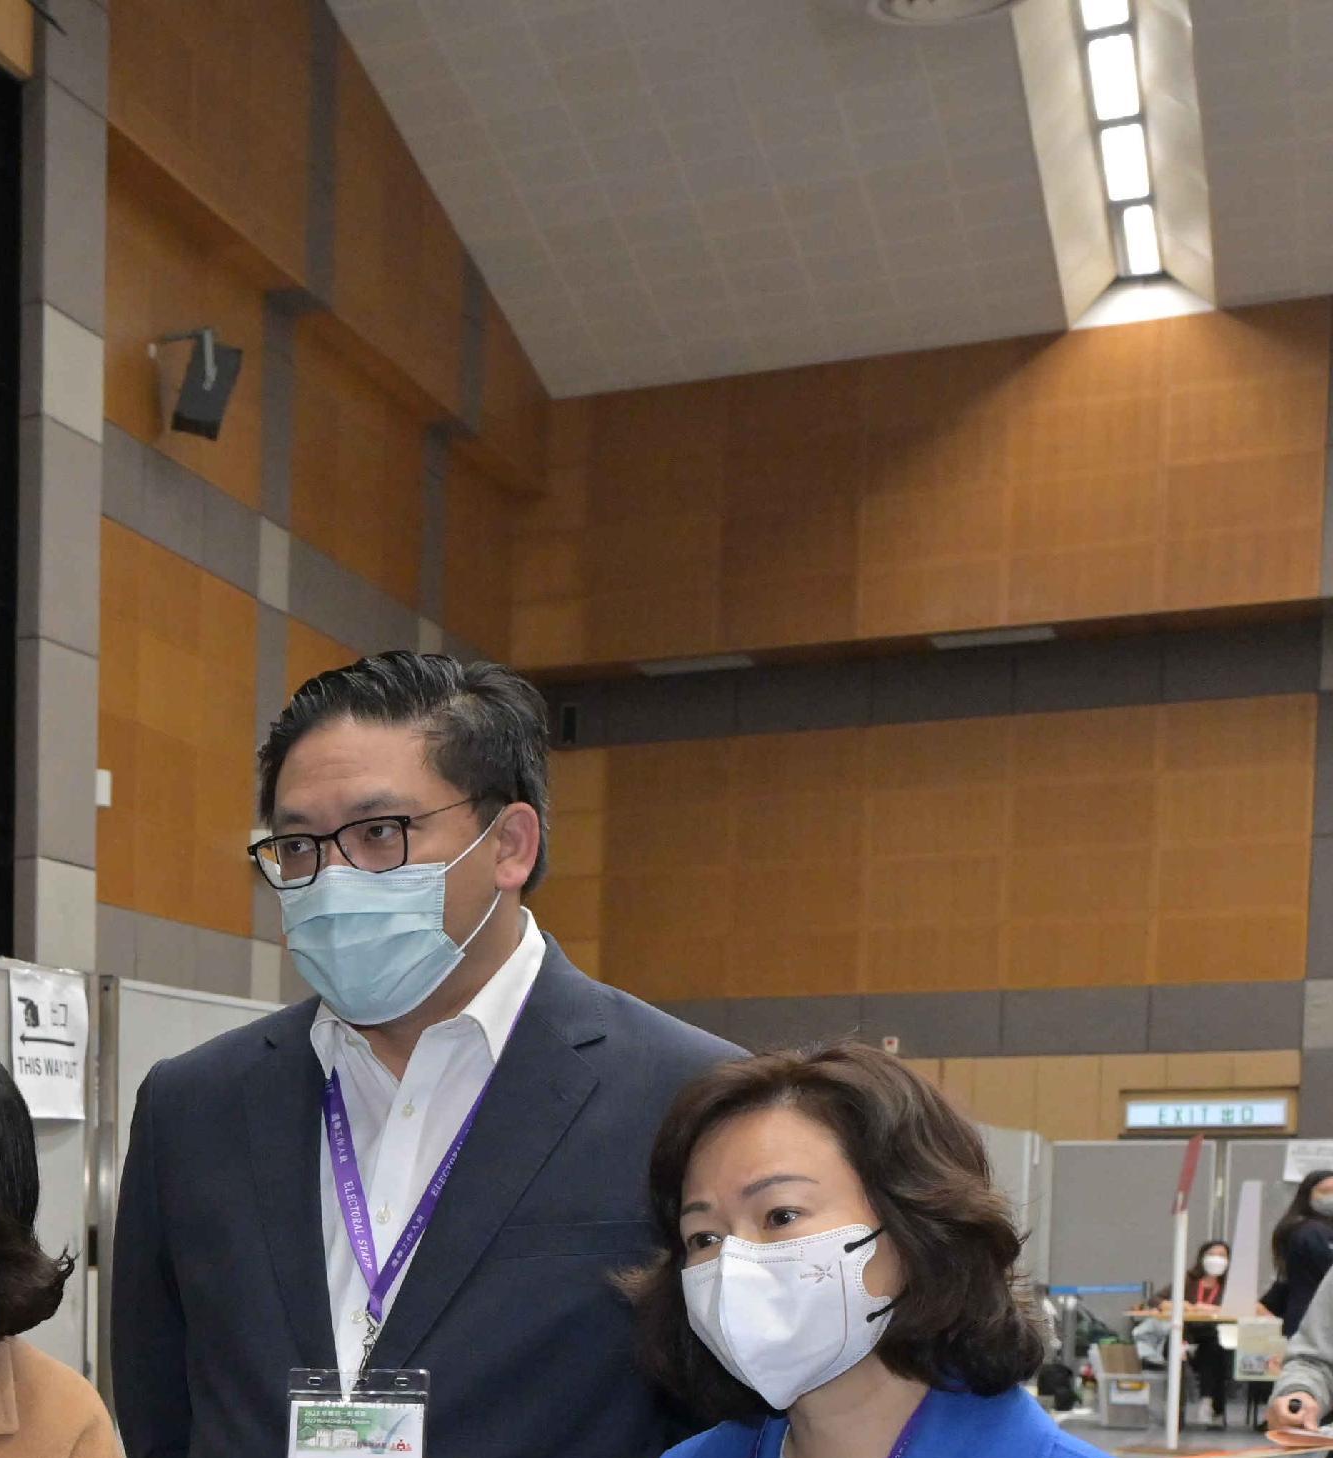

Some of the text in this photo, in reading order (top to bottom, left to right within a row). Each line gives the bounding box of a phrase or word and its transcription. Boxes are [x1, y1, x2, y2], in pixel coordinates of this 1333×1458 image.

[18, 1056, 42, 1077] THIS
[1159, 1104, 1255, 1125] EXIT 出口
[342, 1180, 373, 1271] ELECTORAL STAFF
